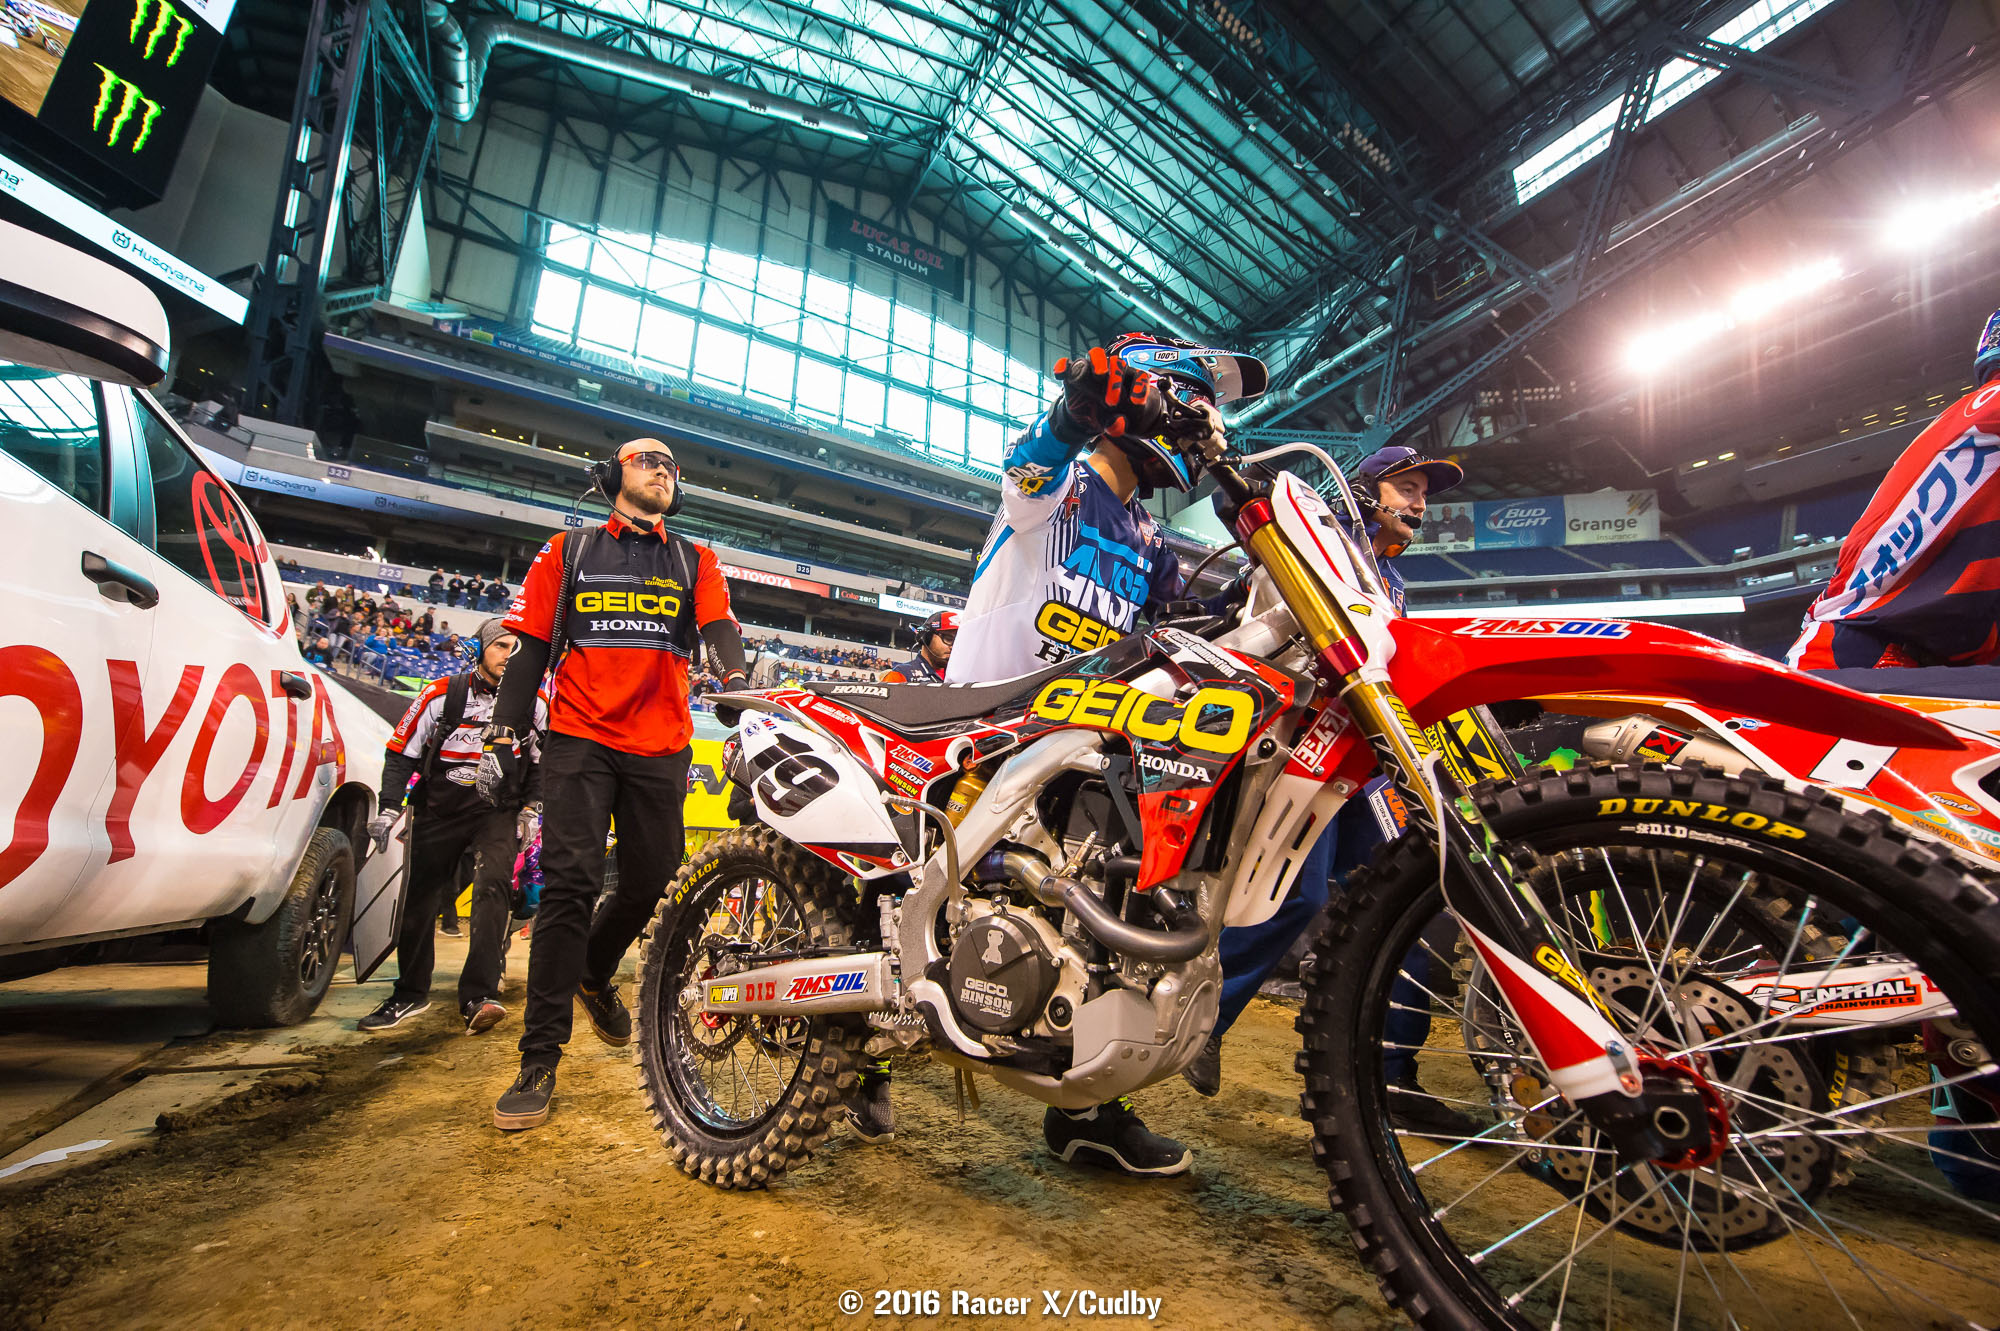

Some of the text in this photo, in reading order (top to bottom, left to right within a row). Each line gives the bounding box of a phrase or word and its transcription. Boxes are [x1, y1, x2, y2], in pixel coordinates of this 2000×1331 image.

[850, 219, 945, 271] LUCAS OIL
[131, 243, 206, 293] Husqvarna
[866, 242, 928, 276] STADIUM
[1157, 352, 1177, 360] 100%
[603, 370, 639, 386] LOCATION
[779, 422, 809, 436] LOCATION
[328, 466, 350, 479] 323
[259, 474, 317, 495] Husqvarna
[1497, 515, 1552, 529] LIGHT
[1504, 508, 1547, 518] BUD
[1568, 517, 1639, 533] Grange
[1839, 434, 2000, 616] フォックス
[379, 565, 402, 580] 223
[741, 570, 792, 590] TOYOTA
[796, 564, 811, 574] 325
[575, 591, 681, 618] GEICO
[841, 590, 877, 604] Coke zero
[589, 619, 671, 635] HONDA
[1037, 602, 1126, 650] GEIC
[1454, 619, 1631, 639] AMSOIL
[1188, 642, 1238, 679] Connection
[830, 685, 889, 698] HONDA
[1030, 678, 1255, 754] GEICO
[889, 744, 936, 774] AMSOIL
[1138, 752, 1212, 783] HONDA
[745, 732, 841, 818] 19
[888, 762, 924, 786] DUNLOP
[889, 774, 919, 796] HINSON
[1374, 795, 1387, 819] FACTORY
[1383, 787, 1408, 829] KTM
[1932, 794, 1959, 809] Twin
[1597, 797, 1808, 841] DUNLOP
[674, 858, 720, 905] DUNLOP
[781, 970, 868, 1004] AMSOIL
[964, 976, 1009, 998] GEICO
[1536, 945, 1620, 1030] GEIC
[960, 988, 1013, 1012] HINSON
[1815, 996, 1916, 1011] CHAINWHEELS
